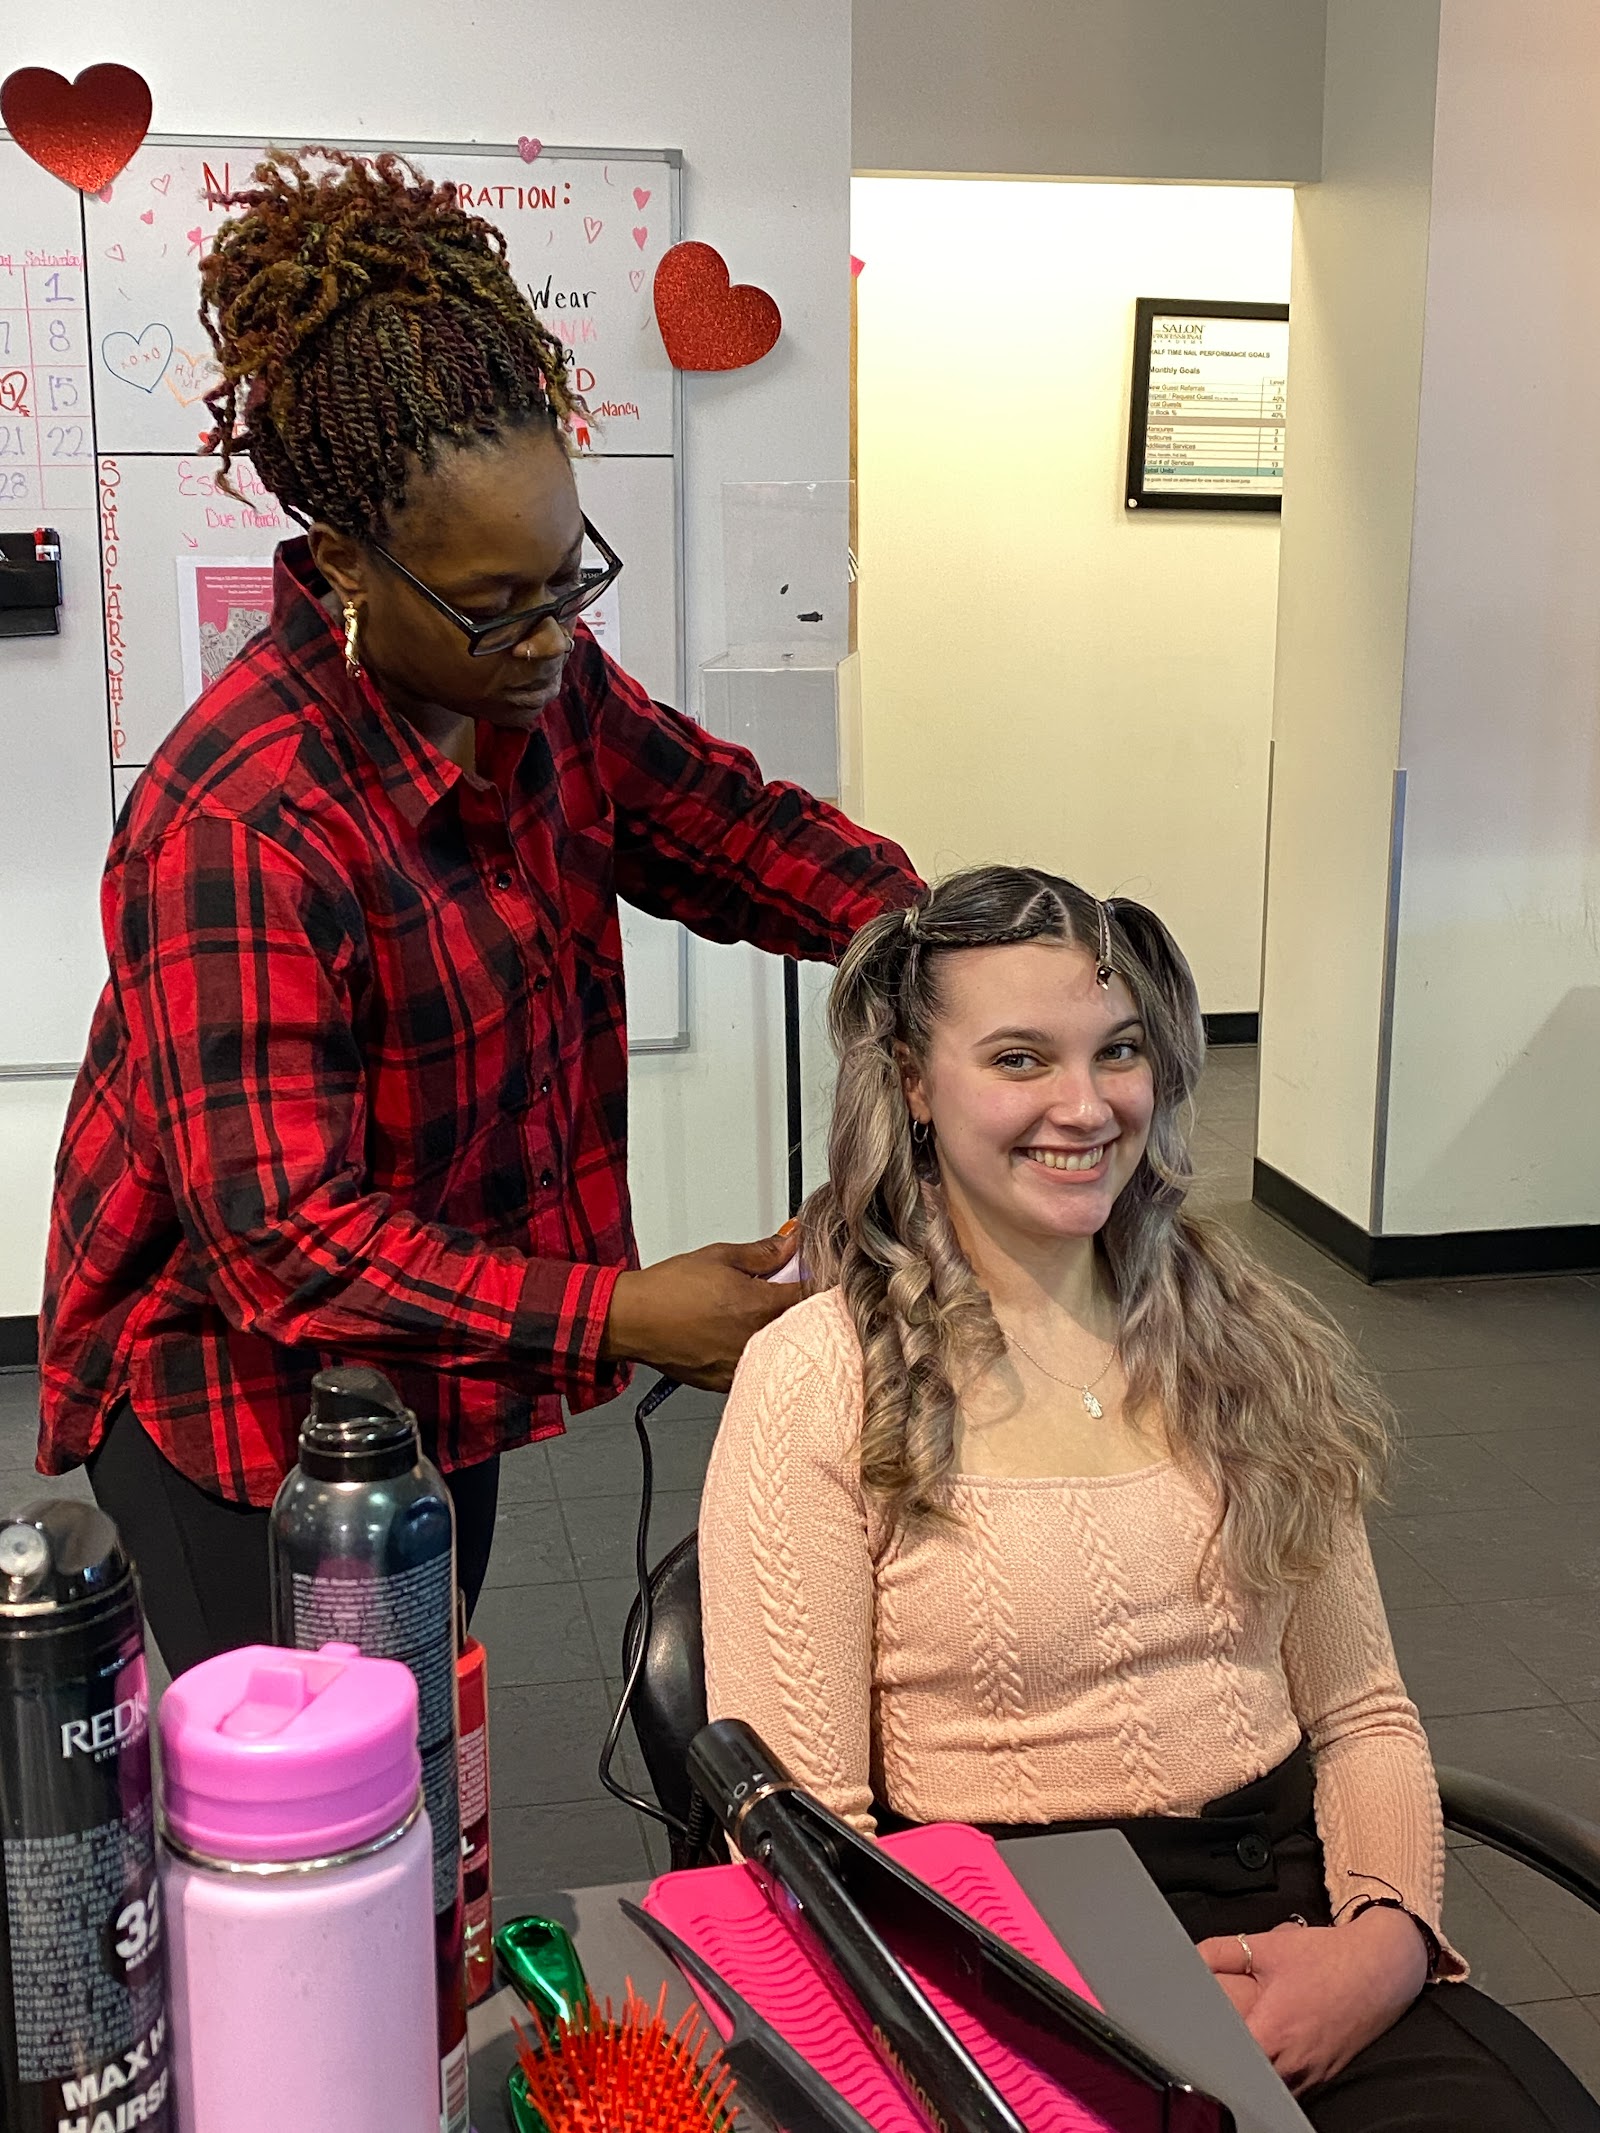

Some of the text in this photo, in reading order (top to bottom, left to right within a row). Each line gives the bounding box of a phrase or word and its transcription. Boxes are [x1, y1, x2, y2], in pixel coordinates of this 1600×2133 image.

[25, 249, 83, 272] Saturday
[44, 273, 75, 303] 1
[528, 275, 596, 310] Wear
[50, 319, 71, 352] 8
[1163, 324, 1203, 333] SALON
[49, 375, 78, 411] 15
[602, 400, 640, 421] Nancy
[0, 426, 92, 456] 21 22
[0, 473, 28, 499] 28
[206, 508, 236, 528] Due
[100, 460, 127, 759] SCHOLARSHIP
[62, 2041, 149, 2111] MAX
